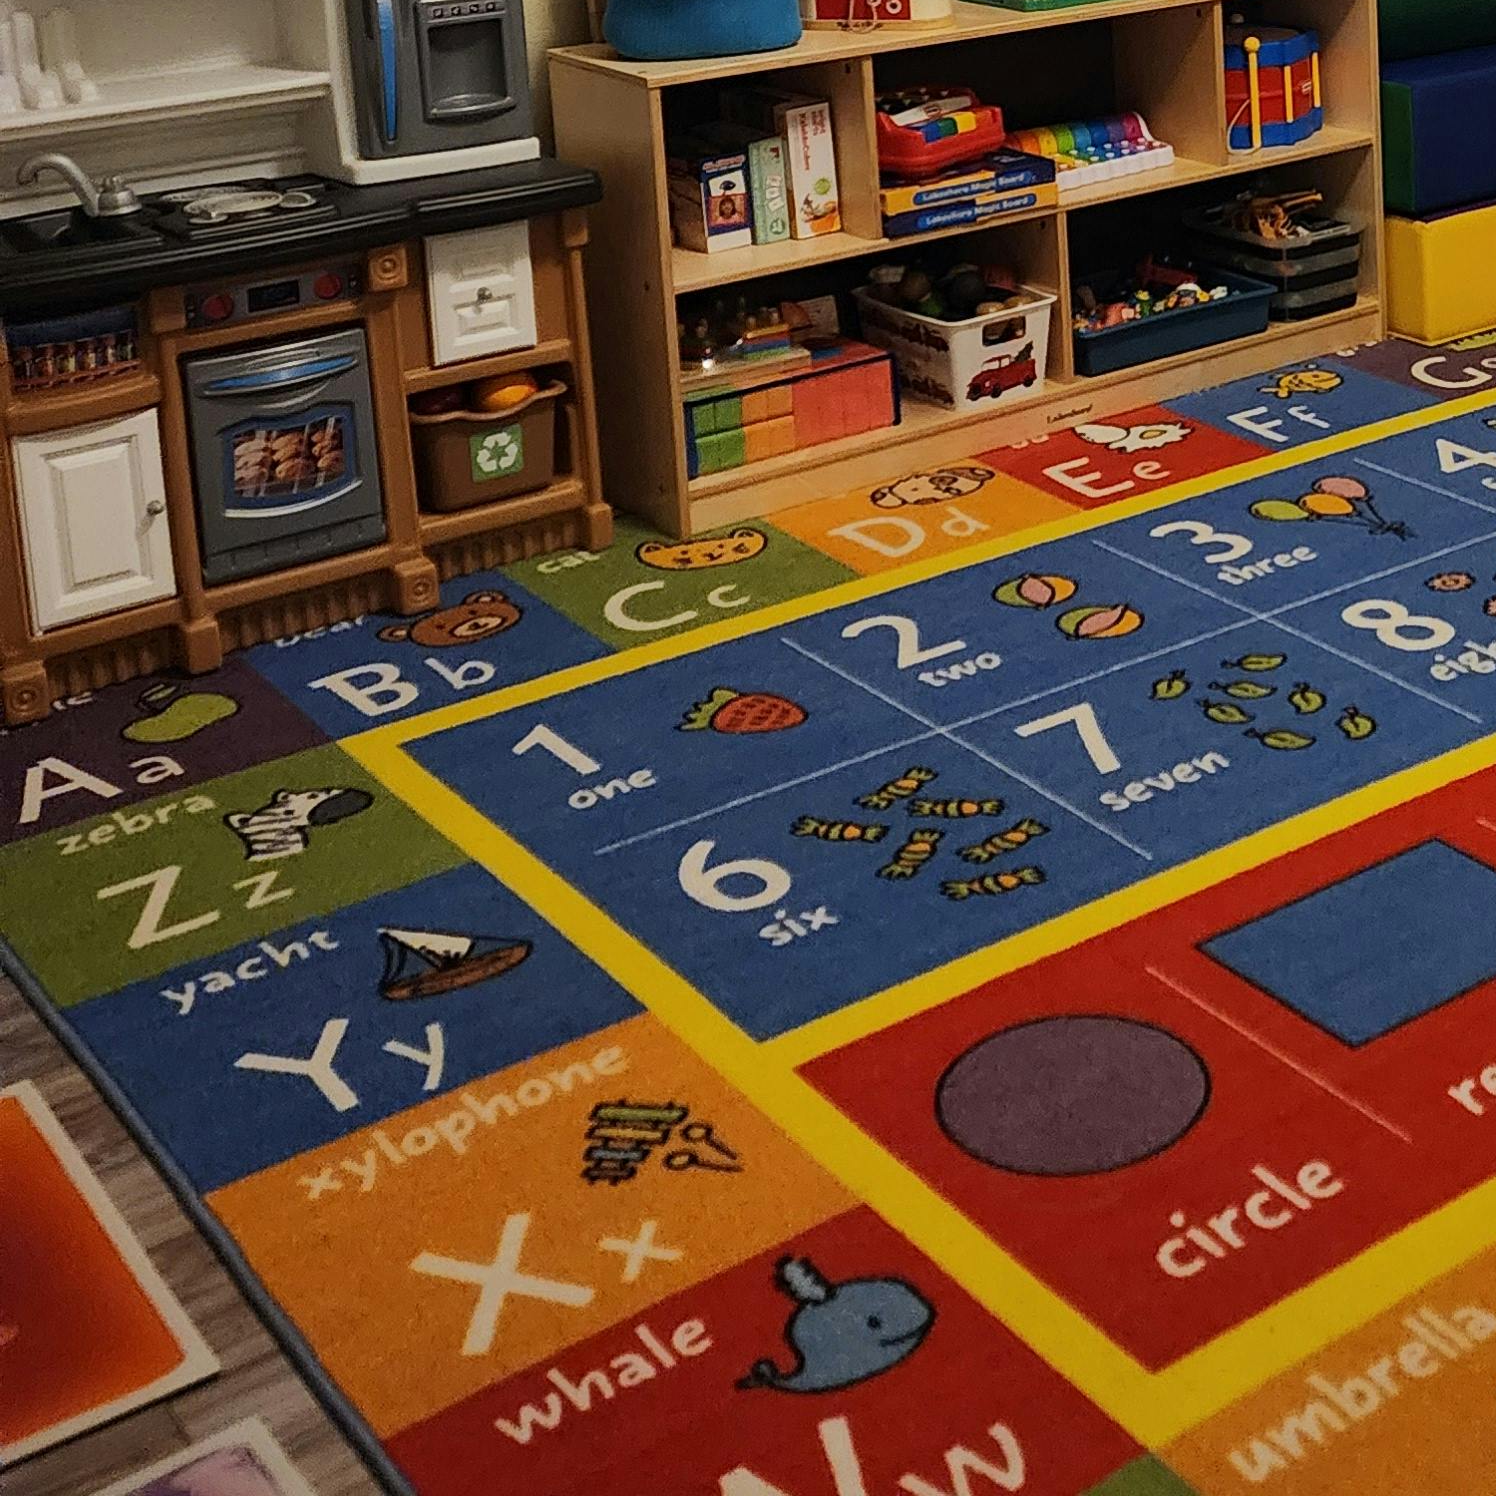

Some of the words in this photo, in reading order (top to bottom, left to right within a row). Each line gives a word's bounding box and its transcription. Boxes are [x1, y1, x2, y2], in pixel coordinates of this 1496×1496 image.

[1226, 405, 1332, 443] Ff
[1042, 455, 1170, 498] Ee
[828, 507, 991, 558] Dd
[1148, 520, 1254, 564] 3
[1216, 543, 1319, 586] three
[603, 579, 751, 631] Cc
[1340, 599, 1456, 652] 8
[841, 615, 967, 670] 2
[917, 650, 1003, 687] two
[307, 655, 497, 718] Bb
[511, 723, 600, 776] 1
[1013, 702, 1121, 775] 7
[18, 754, 187, 824] Aa
[567, 767, 660, 810] one
[1097, 746, 1231, 814] seven
[56, 790, 219, 857] zebra
[678, 839, 791, 913] 6
[97, 865, 295, 951] Zz
[757, 904, 842, 947] six
[159, 927, 342, 1016] yacht
[233, 1017, 446, 1114] Yy
[297, 1043, 632, 1203] xylophone
[1153, 1154, 1345, 1281] circle
[409, 1212, 685, 1356] Xx
[493, 1315, 715, 1447] whale
